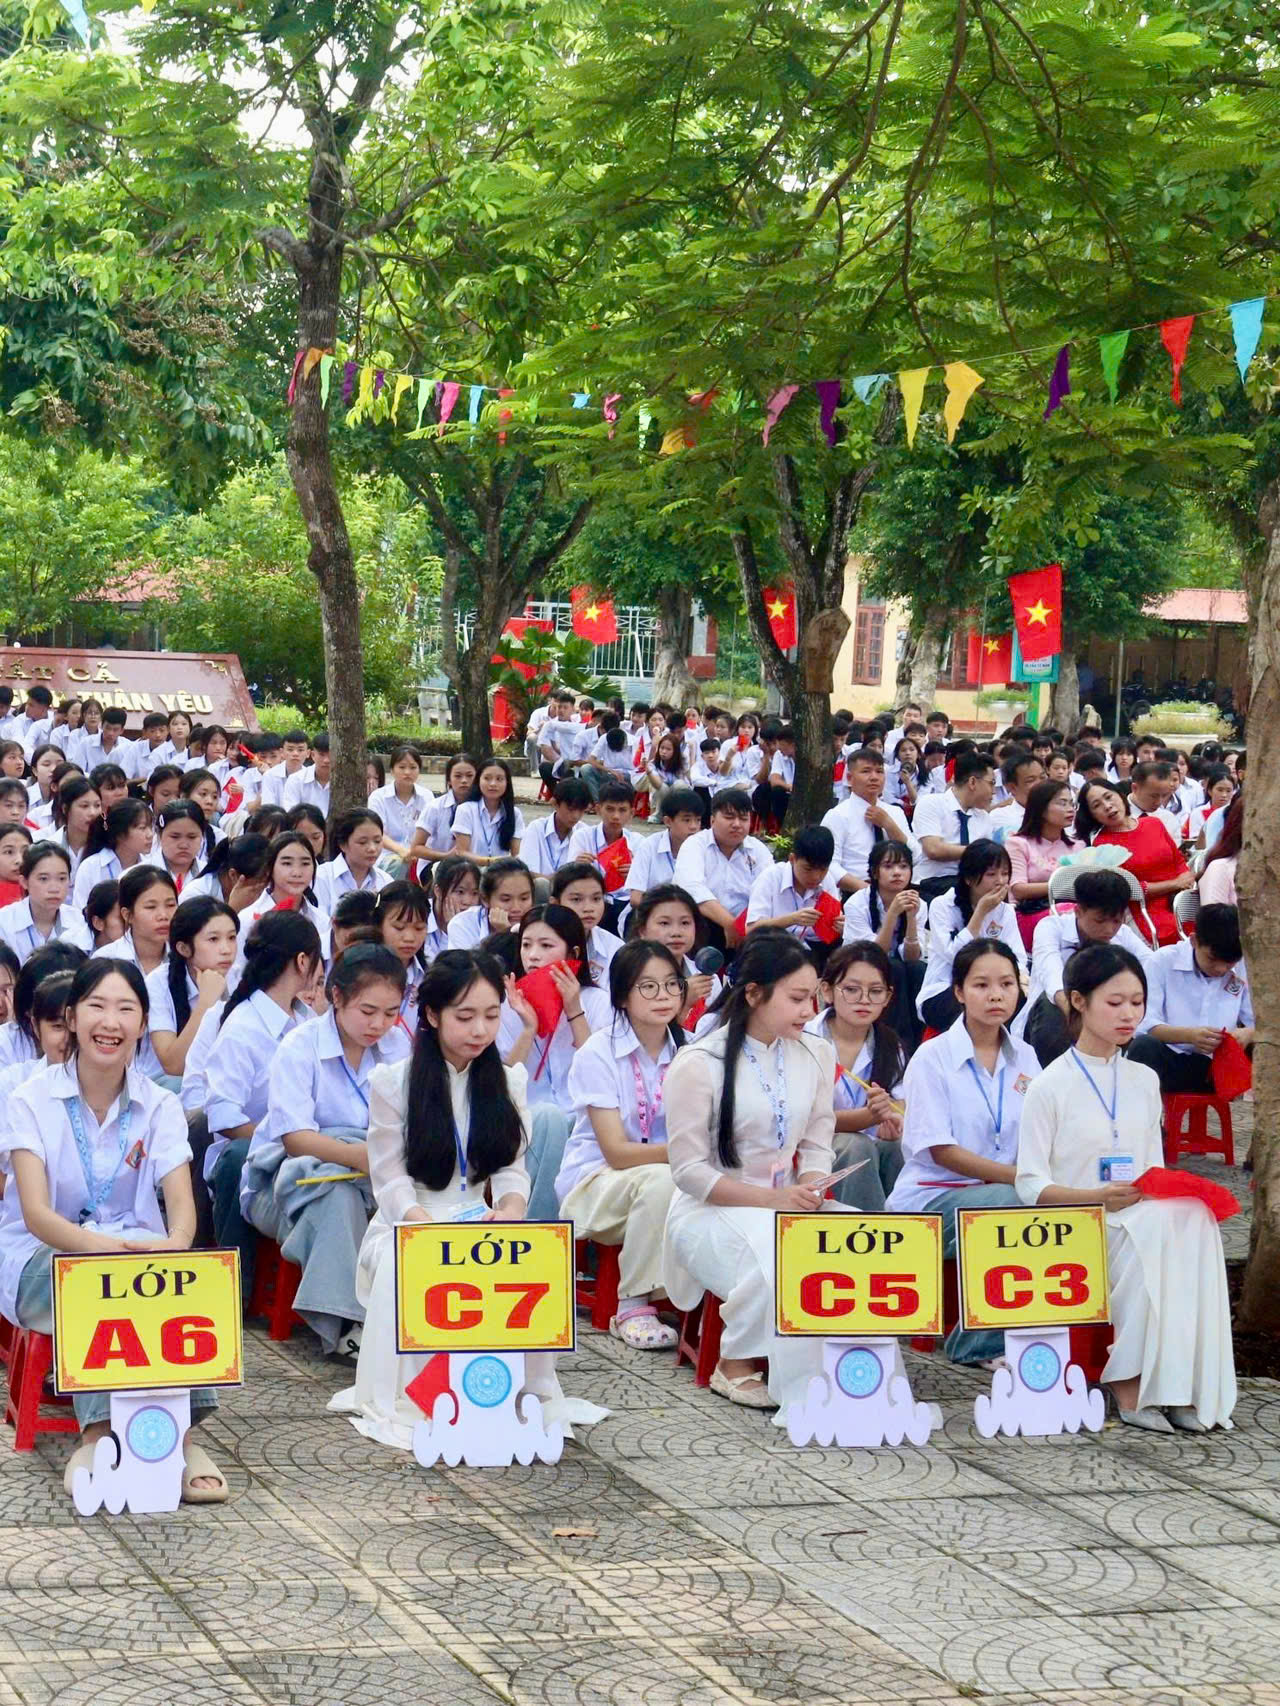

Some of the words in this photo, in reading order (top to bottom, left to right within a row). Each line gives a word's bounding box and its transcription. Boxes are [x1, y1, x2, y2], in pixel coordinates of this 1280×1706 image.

[67, 661, 120, 683] CẢ
[158, 689, 214, 714] YÊU
[439, 1233, 533, 1266] LỚP
[816, 1223, 905, 1255] LỚP
[995, 1217, 1074, 1249] LỚP
[100, 1263, 198, 1299] LỚP
[800, 1272, 920, 1318] C5
[984, 1264, 1090, 1310] C3
[425, 1283, 550, 1330] C7
[83, 1316, 218, 1370] A6
